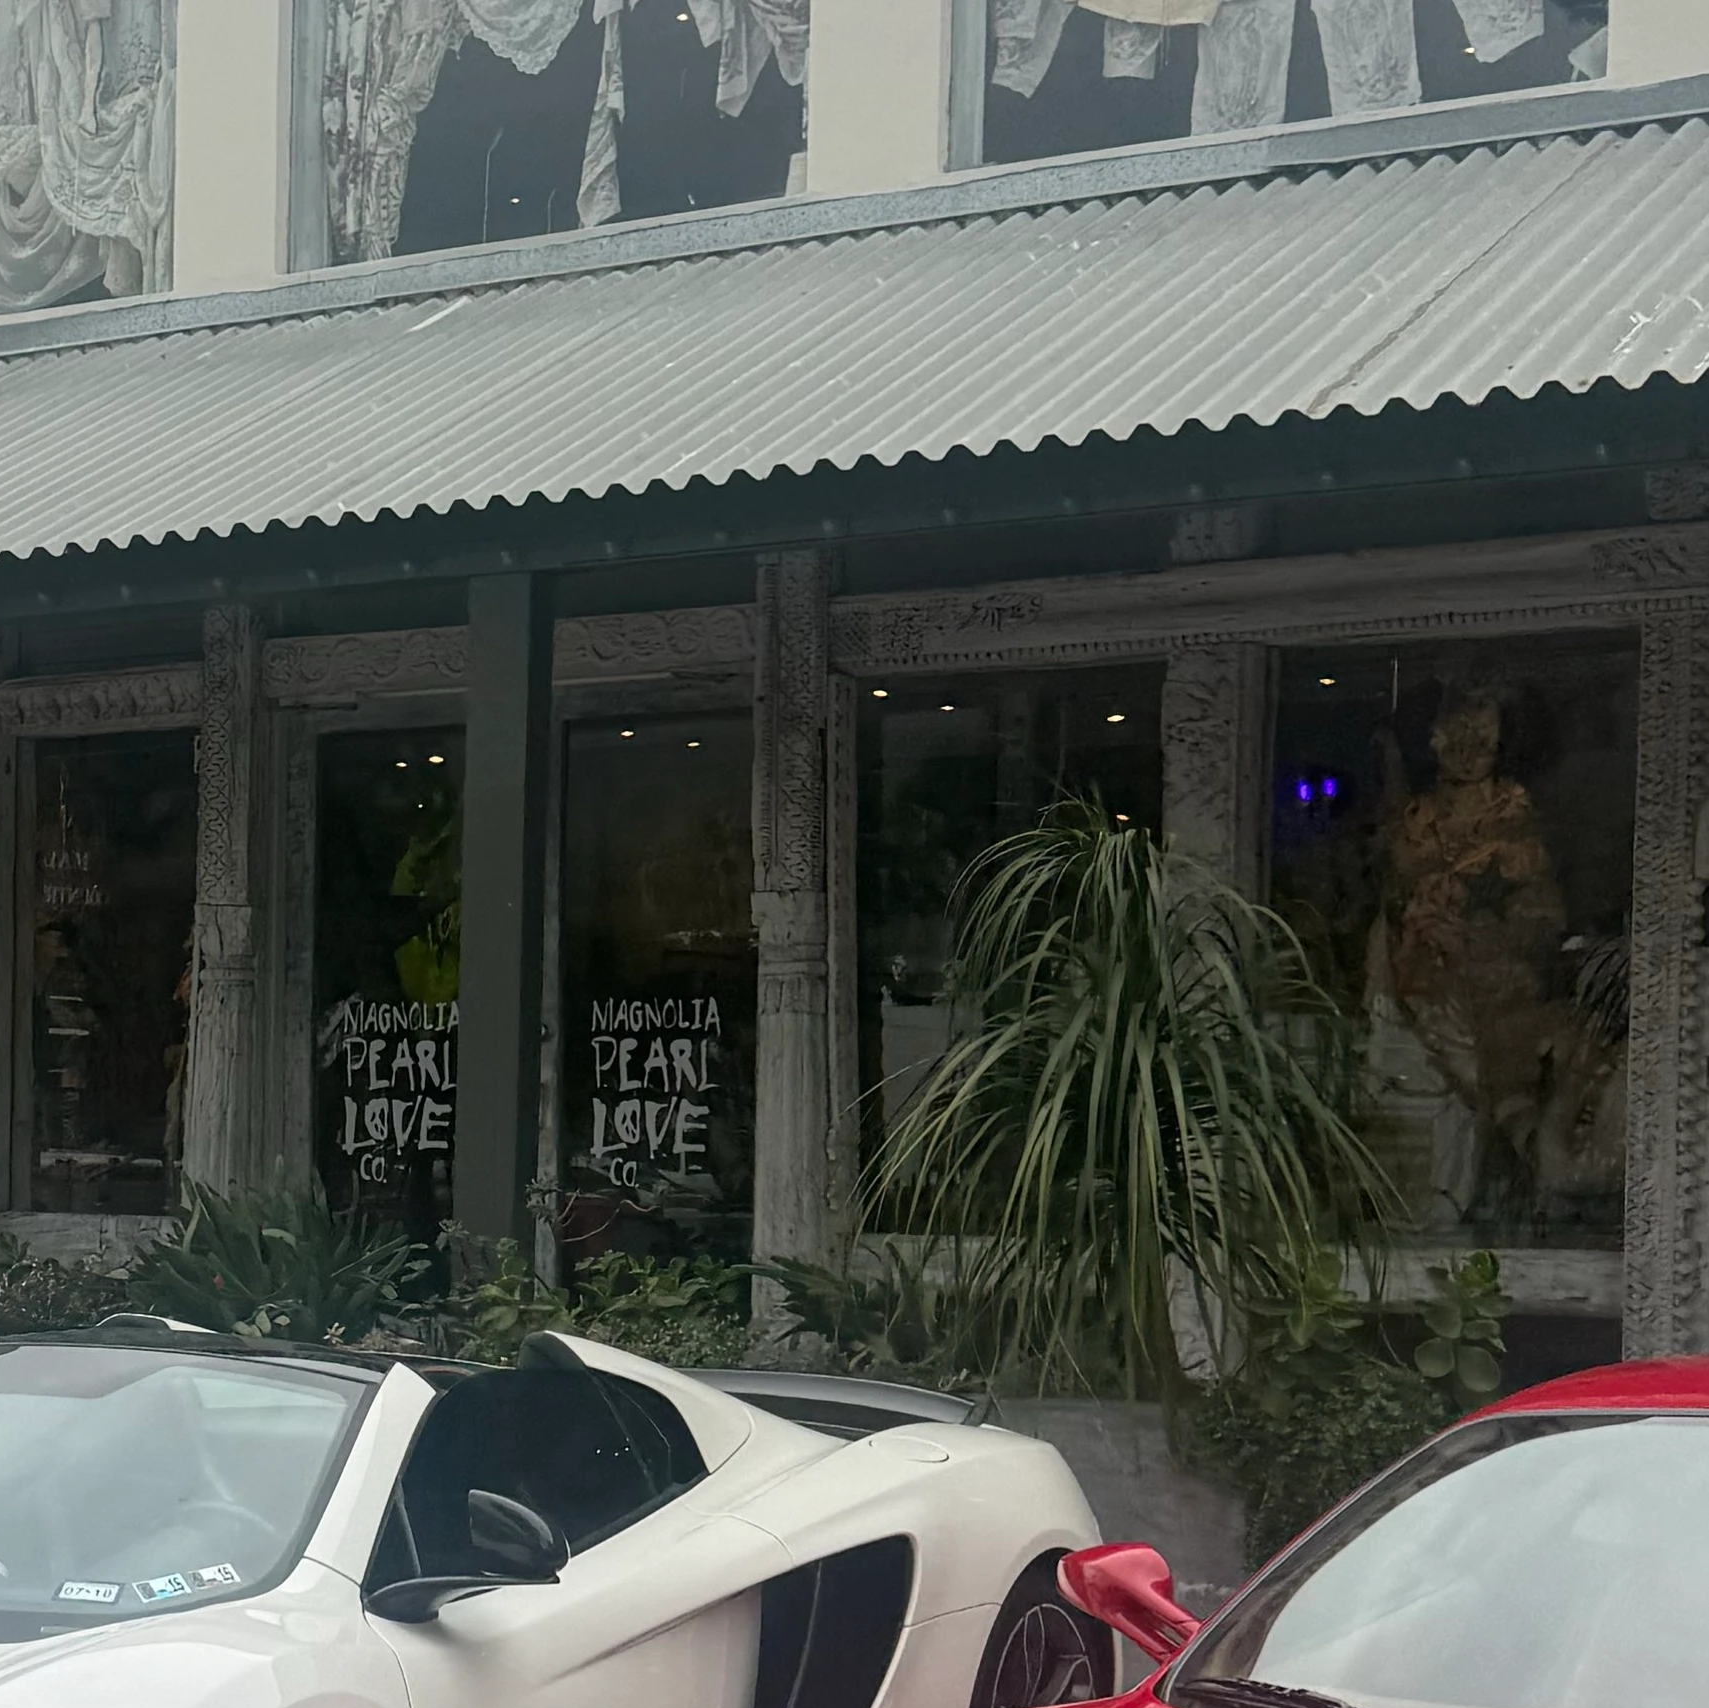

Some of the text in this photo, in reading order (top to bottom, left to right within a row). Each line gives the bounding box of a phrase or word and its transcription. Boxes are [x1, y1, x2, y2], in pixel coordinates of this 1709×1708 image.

[344, 1001, 460, 1034] MAGNOLIA
[591, 996, 722, 1037] MAGNOLIA
[342, 1037, 458, 1092] PEARL
[591, 1036, 721, 1093] PEARL
[341, 1095, 453, 1156] LOVE
[590, 1096, 711, 1159] LOVE
[360, 1153, 388, 1184] CO.
[610, 1158, 640, 1188] CO.
